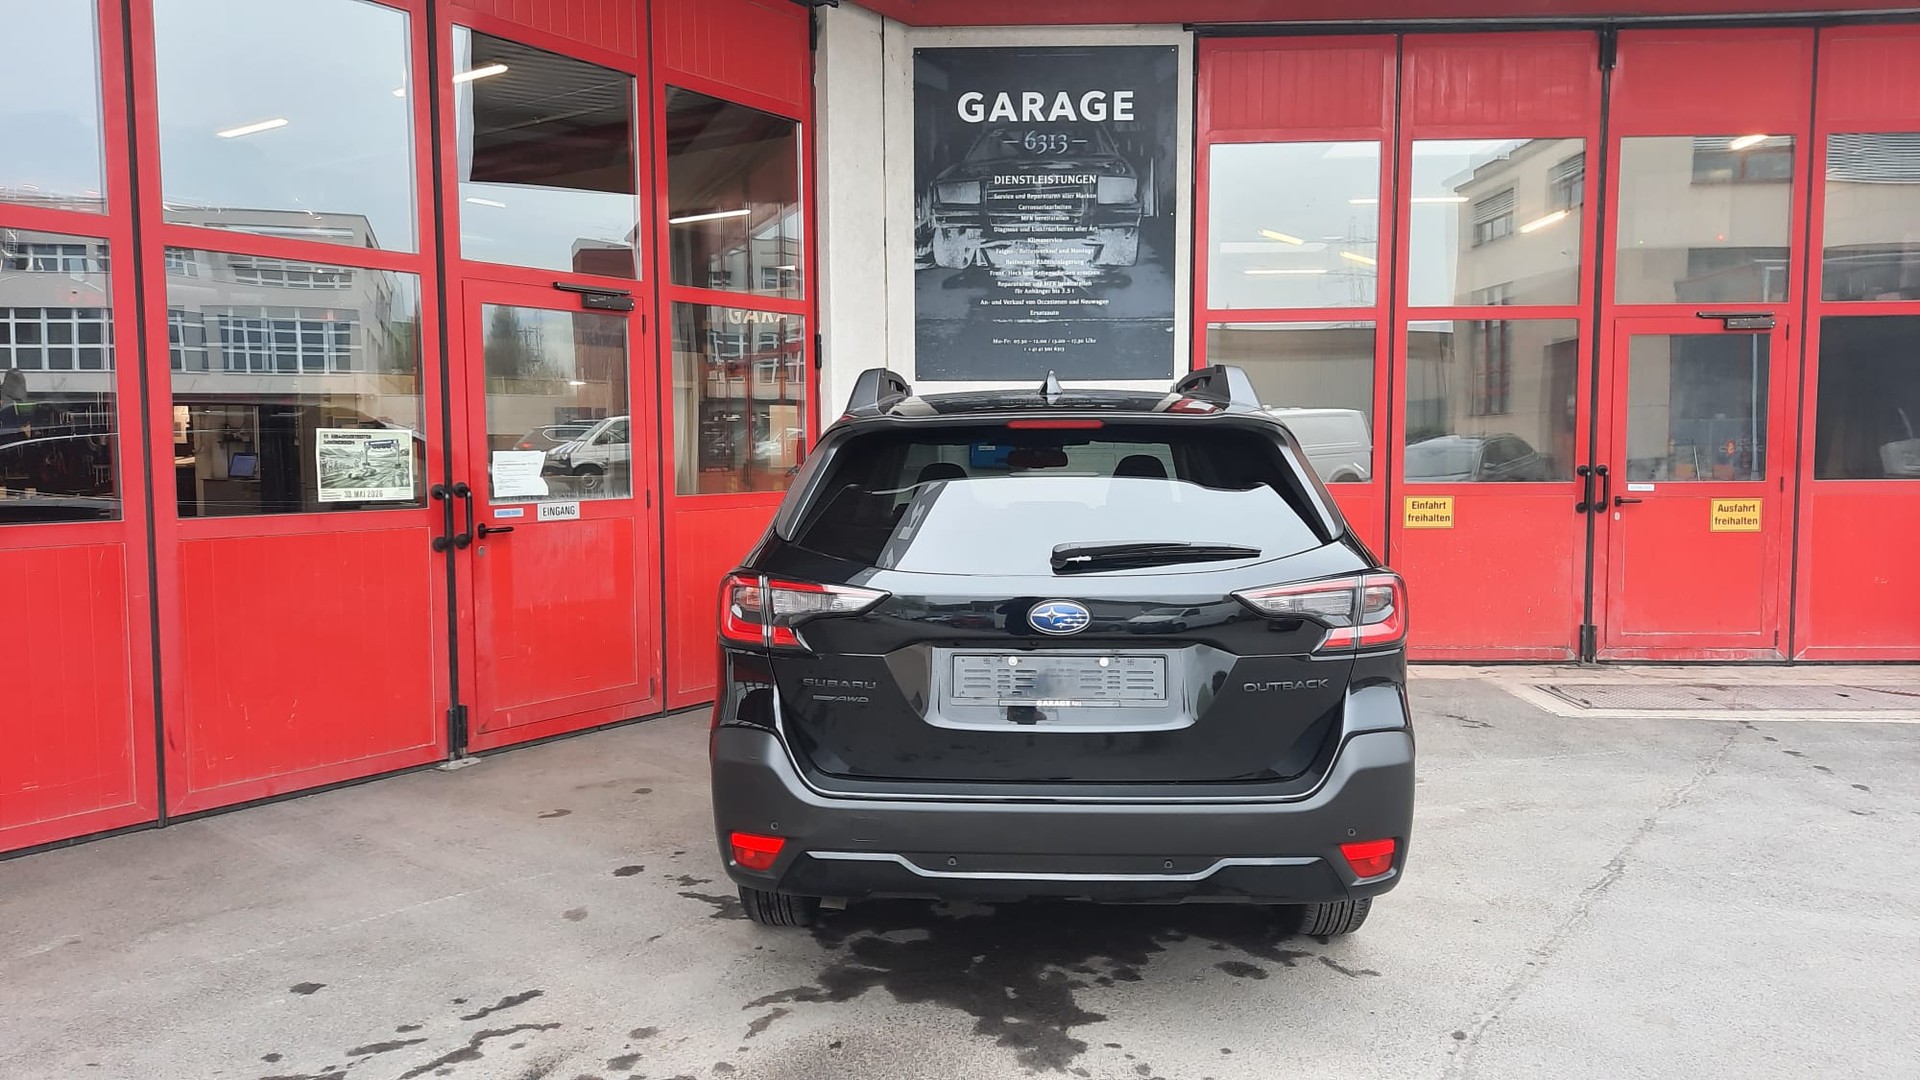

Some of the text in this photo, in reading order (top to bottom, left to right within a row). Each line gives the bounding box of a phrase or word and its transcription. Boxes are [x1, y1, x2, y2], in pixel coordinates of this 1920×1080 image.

[957, 90, 1134, 123] GARAGE
[1024, 130, 1068, 154] 6313
[994, 175, 1096, 184] DIENSTLEISTUNGEN
[1411, 500, 1446, 510] Einfahrt
[1717, 504, 1755, 513] Ausfahrt
[542, 505, 575, 517] EINGANG
[1407, 513, 1451, 523] freihalten
[1714, 517, 1758, 525] freihalten
[802, 678, 876, 689] SUBARU
[1243, 678, 1329, 692] OUTBACK
